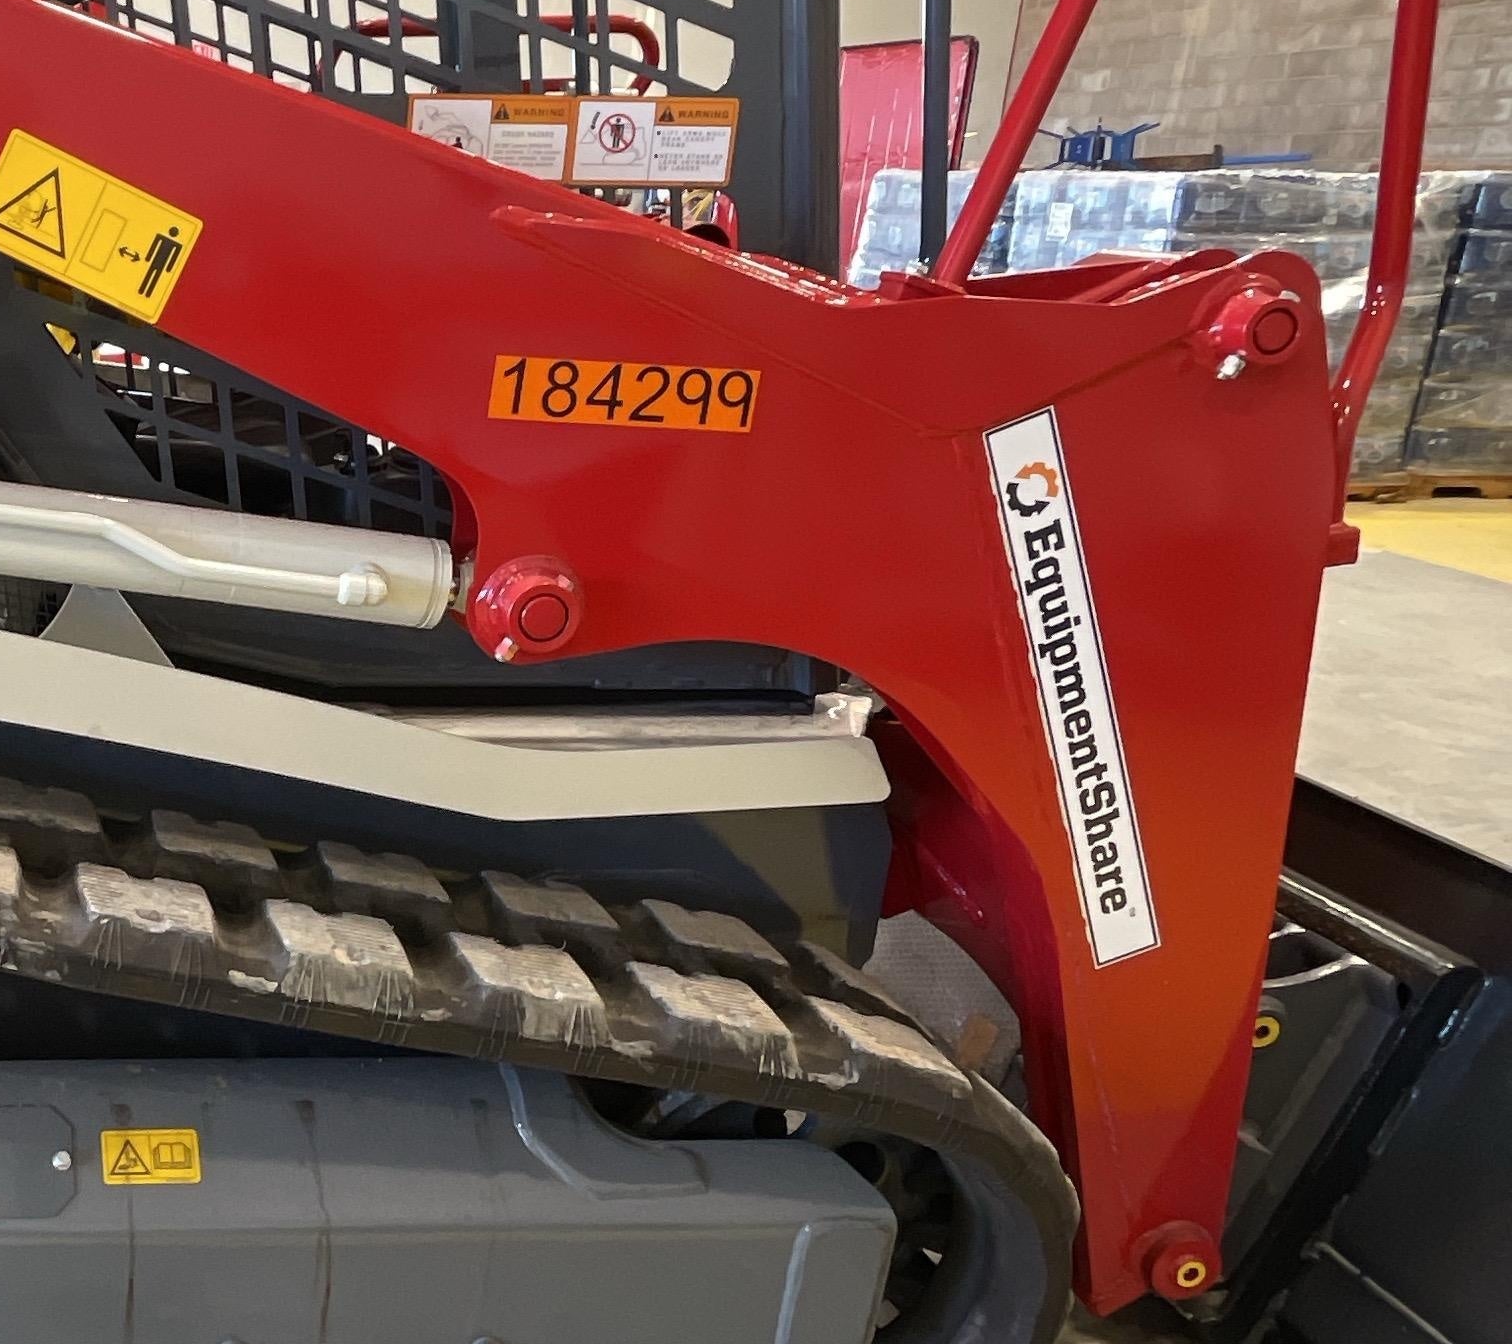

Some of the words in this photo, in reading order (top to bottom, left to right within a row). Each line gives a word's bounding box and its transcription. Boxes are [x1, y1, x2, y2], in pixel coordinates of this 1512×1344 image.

[678, 110, 730, 119] WARNING
[503, 358, 754, 428] 184299
[1023, 518, 1128, 916] EquipmentShare
